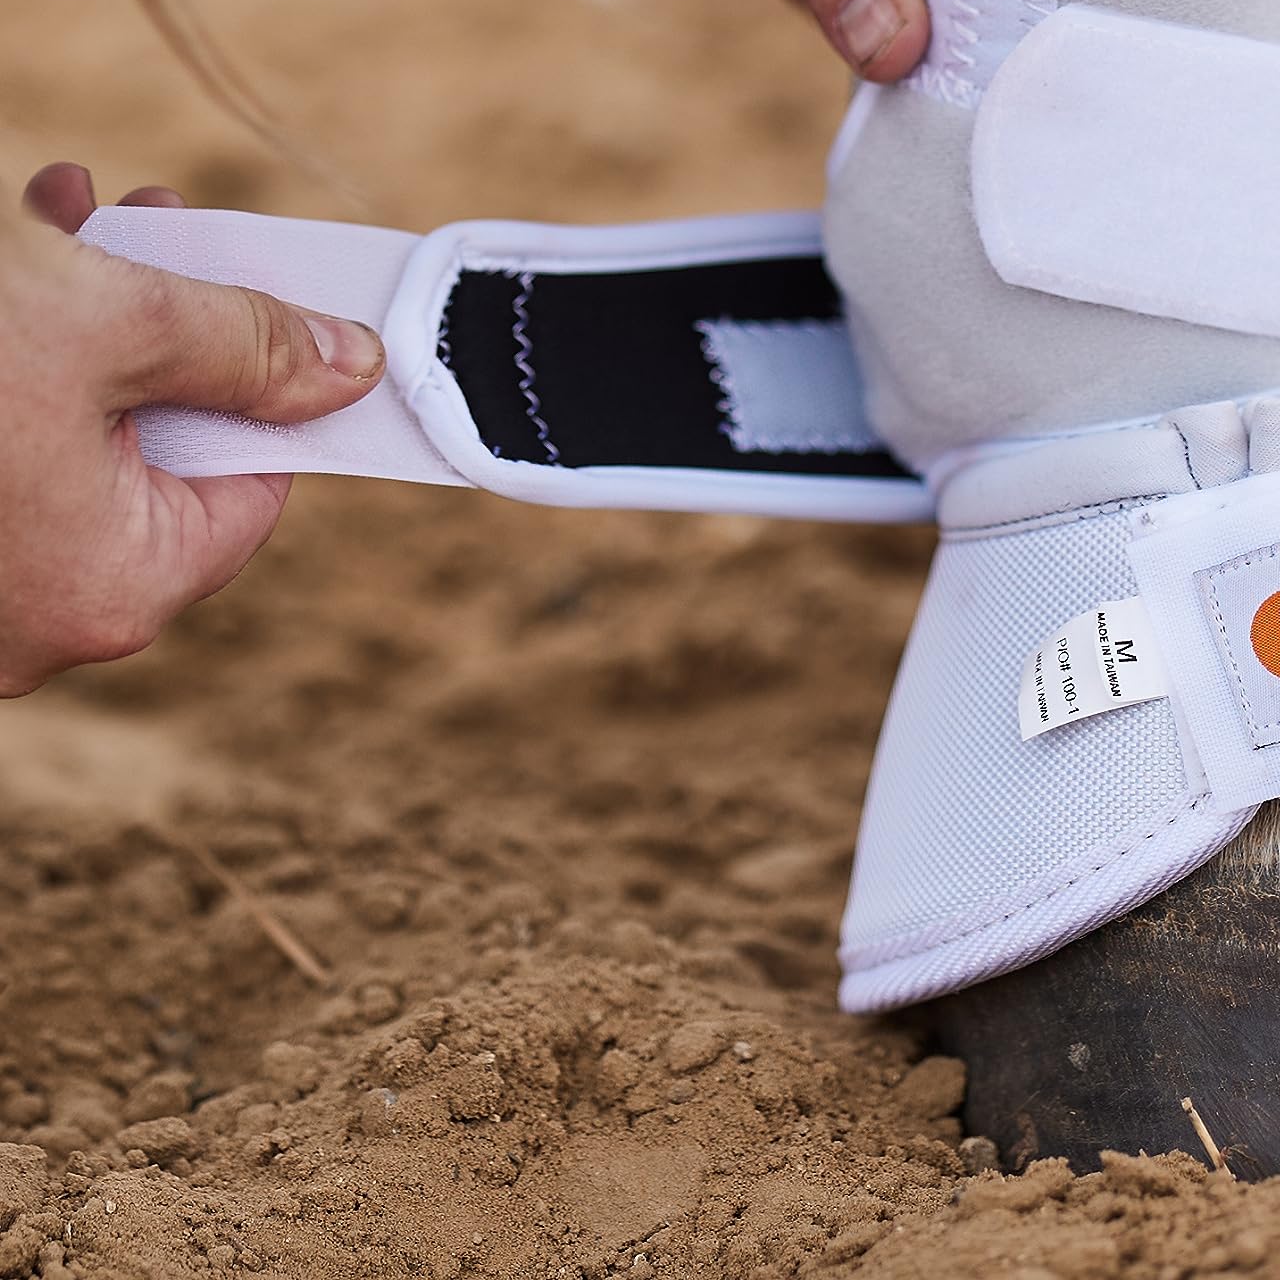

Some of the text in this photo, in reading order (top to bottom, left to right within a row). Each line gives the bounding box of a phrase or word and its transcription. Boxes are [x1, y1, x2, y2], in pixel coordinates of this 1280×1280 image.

[1097, 611, 1122, 697] MADE IN TAIWAN
[1114, 639, 1138, 663] M
[1061, 674, 1080, 715] 100-1
